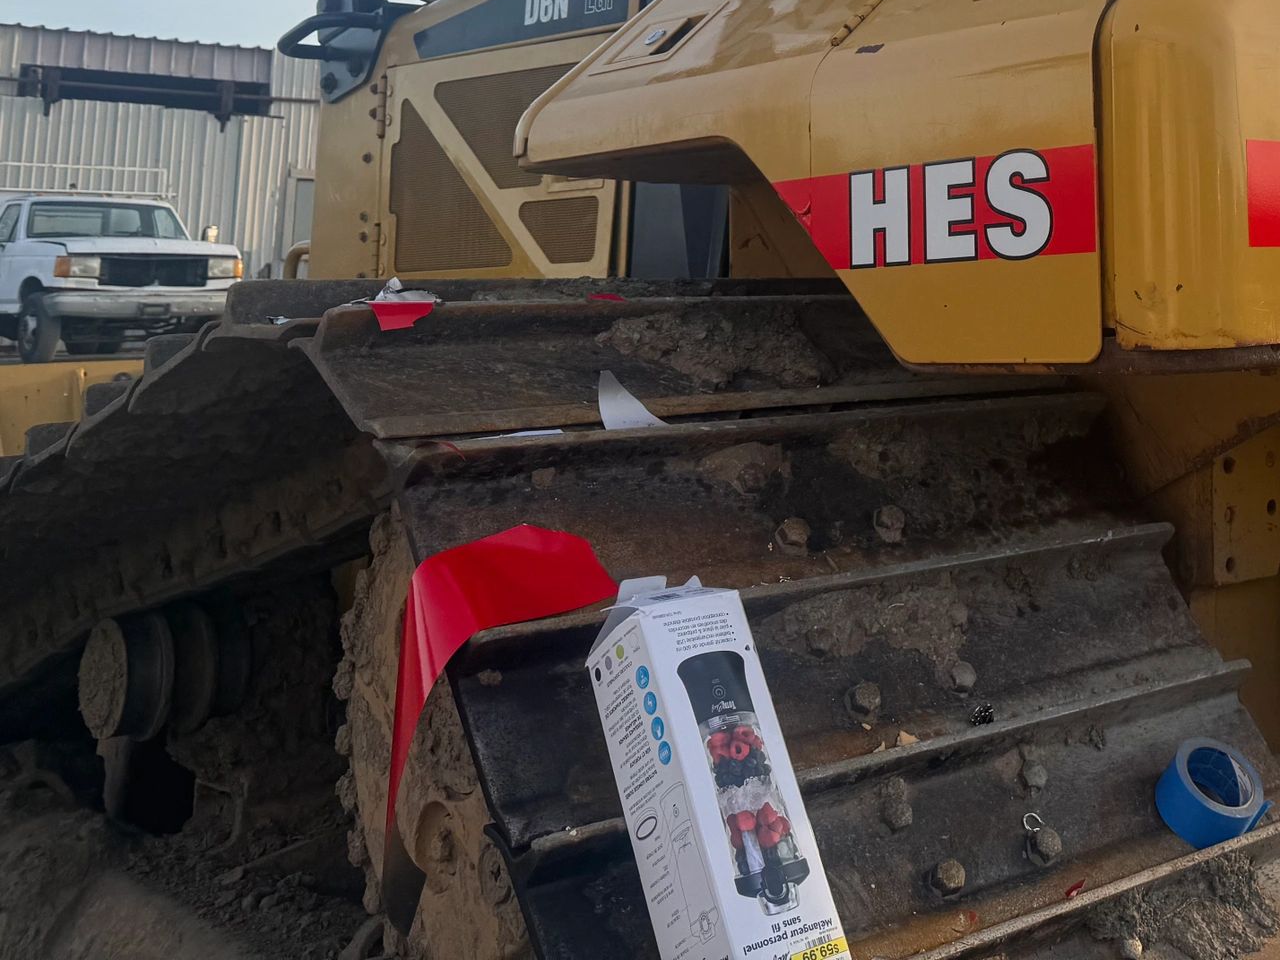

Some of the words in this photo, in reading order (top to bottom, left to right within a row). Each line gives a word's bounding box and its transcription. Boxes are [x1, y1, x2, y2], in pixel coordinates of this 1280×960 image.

[849, 148, 1053, 269] HES
[771, 923, 781, 934] fil
[782, 915, 802, 928] sans
[790, 918, 833, 938] Mélangeur
[743, 930, 789, 956] personnel
[802, 943, 840, 960] $59.99
